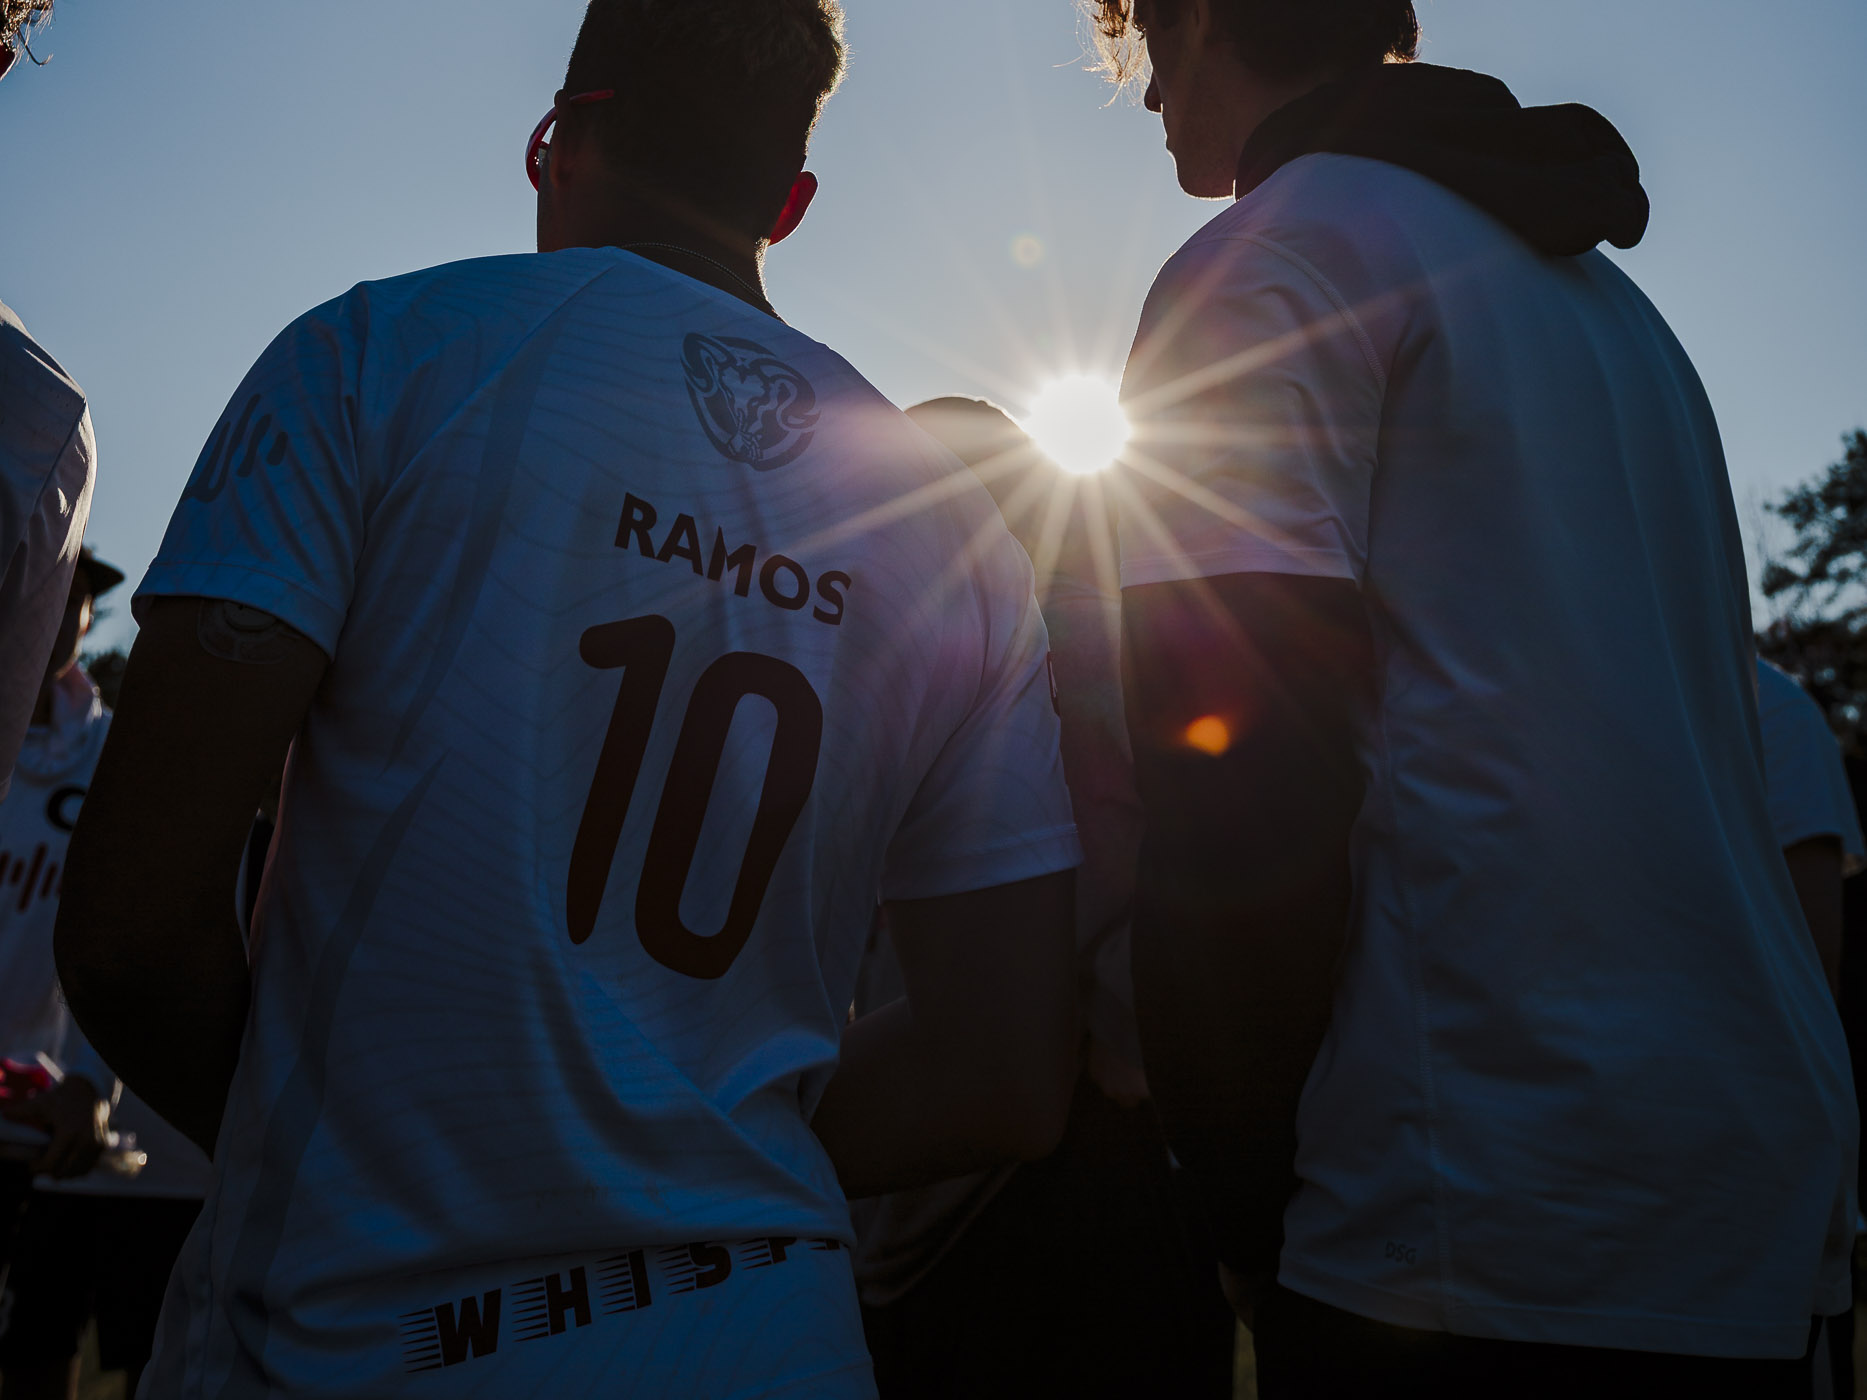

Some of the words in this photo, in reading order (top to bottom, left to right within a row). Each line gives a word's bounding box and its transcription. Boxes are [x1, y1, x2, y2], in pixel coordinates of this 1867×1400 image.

[614, 492, 852, 625] RAMOS
[566, 614, 823, 979] 10
[418, 1237, 840, 1369] WHIS
[1385, 1240, 1417, 1265] DSG
